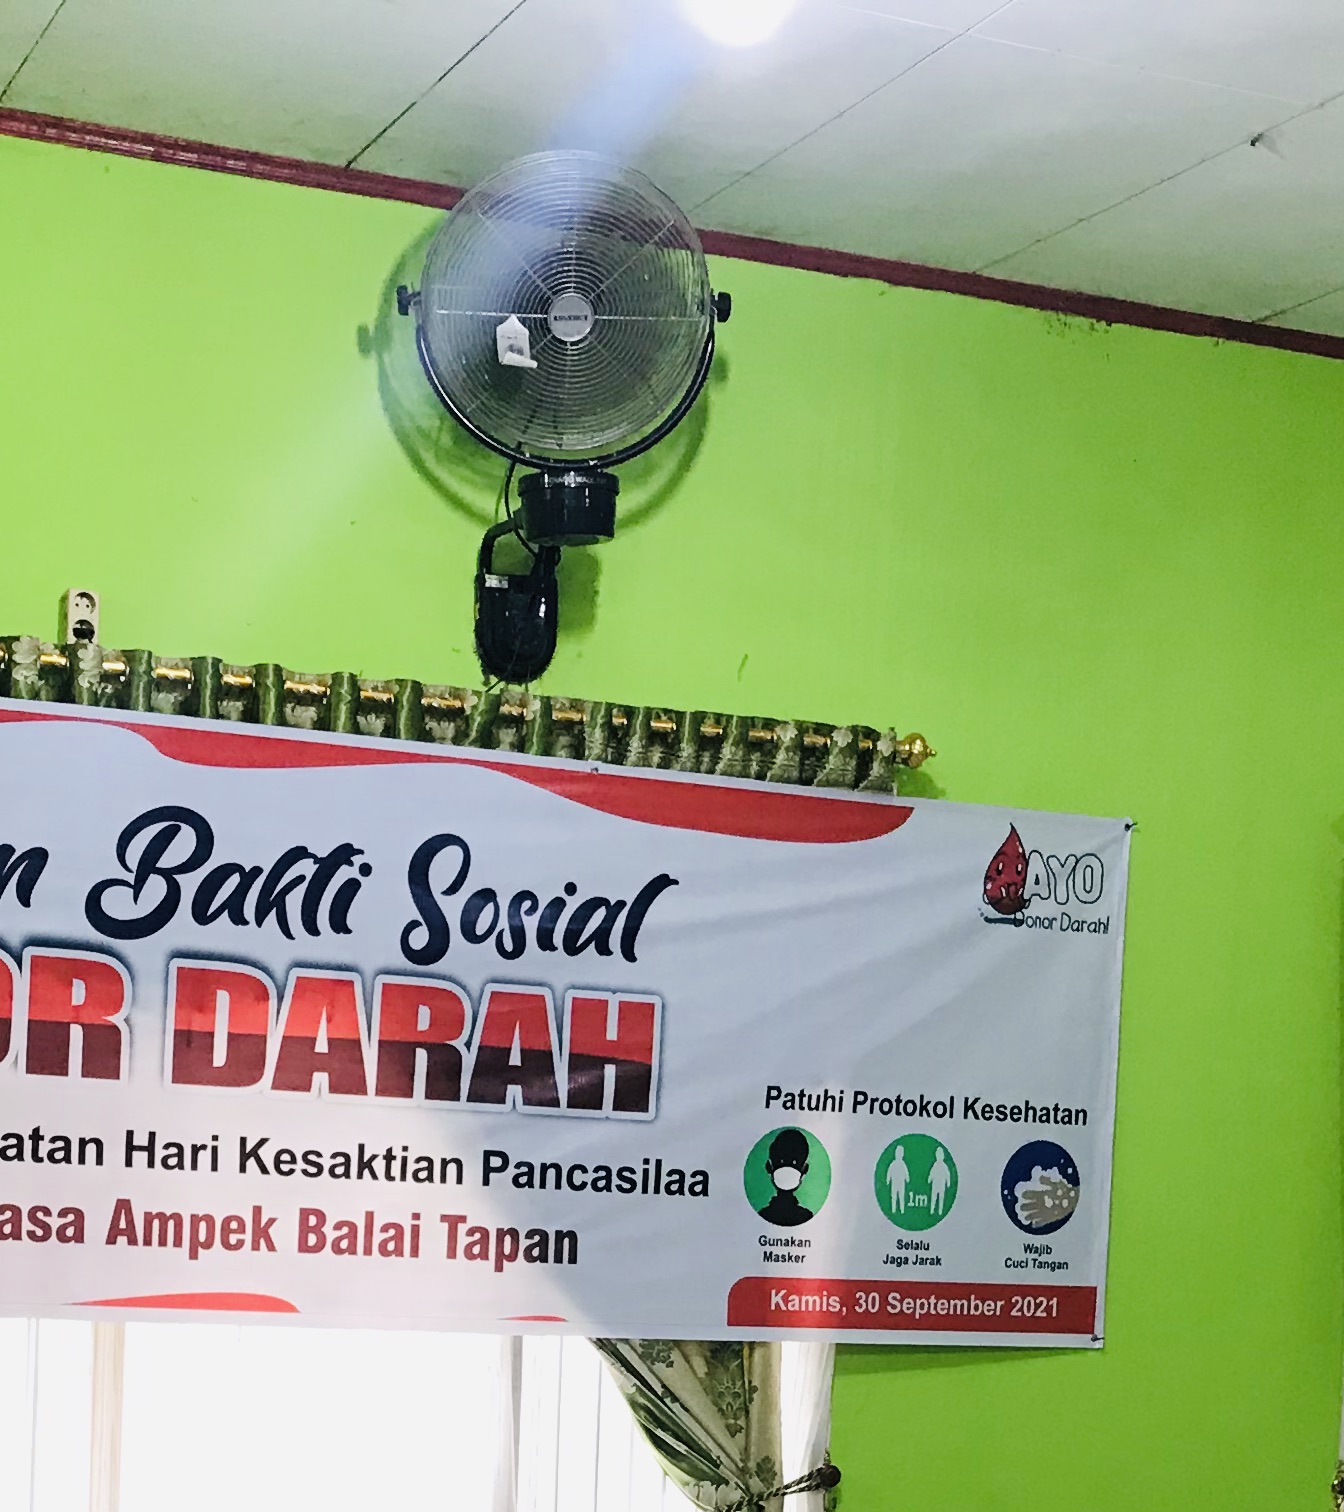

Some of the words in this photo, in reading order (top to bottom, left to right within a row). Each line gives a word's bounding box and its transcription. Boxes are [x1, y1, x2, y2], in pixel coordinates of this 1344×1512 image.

[85, 805, 373, 941] Bakti
[400, 833, 680, 966] Sosial
[1023, 849, 1104, 905] AYO
[1014, 910, 1058, 931] Donor
[170, 966, 657, 1114] DARAH
[764, 1085, 844, 1114] Patuhi
[852, 1090, 955, 1120] Protokol
[963, 1096, 1088, 1127] Kesehatan
[124, 1130, 219, 1173] Hari
[238, 1136, 464, 1186] Kesaktian
[481, 1149, 710, 1198] Pancasilaa
[907, 1191, 929, 1208] 1m
[104, 1197, 278, 1260] Ampek
[297, 1207, 421, 1259] Balai
[439, 1214, 580, 1272] Tapan
[758, 1235, 812, 1250] Gunakan
[895, 1239, 931, 1252] Selalu
[1022, 1243, 1053, 1257] Wajib
[762, 1251, 806, 1264] Masker
[882, 1253, 909, 1267] Jaga
[912, 1254, 942, 1267] Jarak
[1004, 1257, 1029, 1270] Cuci
[1031, 1258, 1069, 1272] Tangan
[770, 1289, 847, 1316] Kamis,
[854, 1291, 880, 1314] 30
[886, 1292, 1004, 1319] September
[1010, 1296, 1059, 1318] 2021
